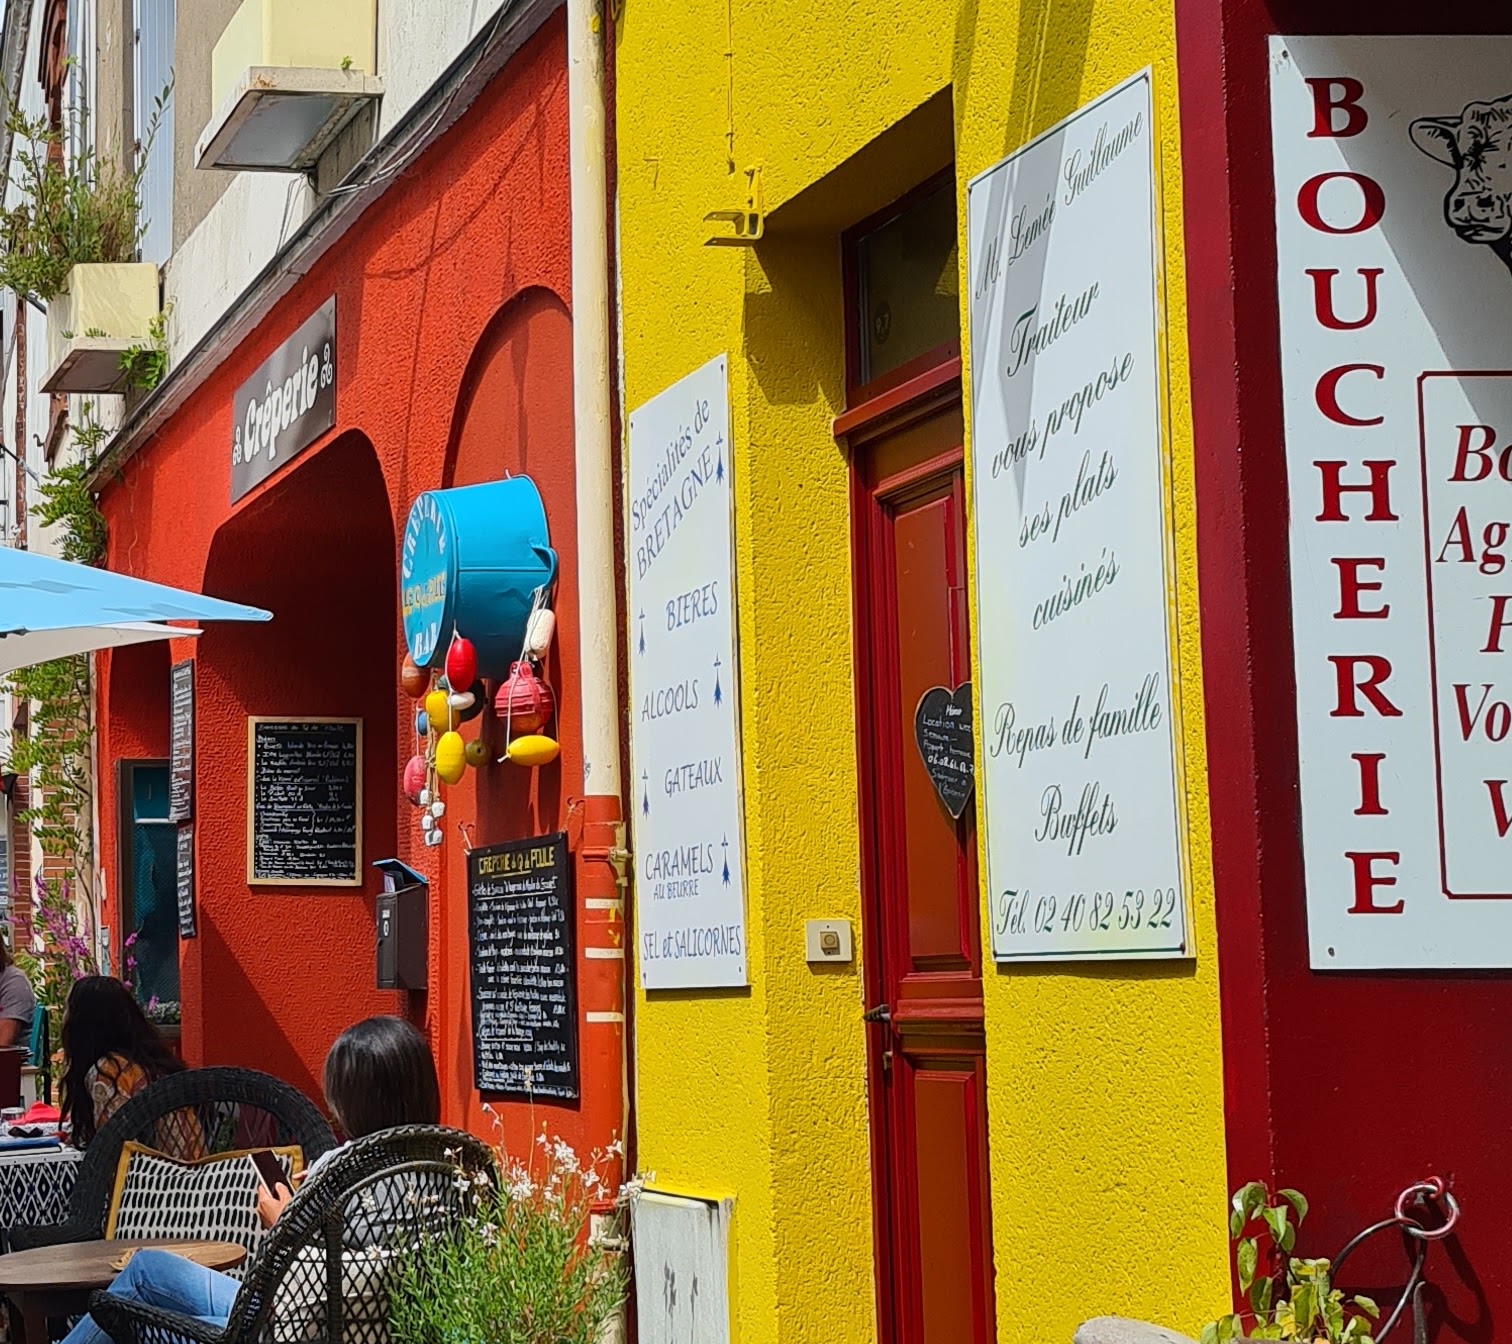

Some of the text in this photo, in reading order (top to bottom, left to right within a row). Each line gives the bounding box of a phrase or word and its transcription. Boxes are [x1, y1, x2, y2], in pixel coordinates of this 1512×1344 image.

[975, 109, 1144, 299] M. Lemée Guillaume
[1007, 279, 1100, 378] Traiteur
[244, 346, 319, 463] Crêperie
[992, 352, 1134, 480] vous propose
[632, 399, 710, 531] Spécialités de
[1020, 449, 1119, 548] ses plats
[1297, 76, 1405, 914] BOUCHERIE
[636, 445, 714, 581] BRETAGNE
[1436, 506, 1512, 575] Ag
[665, 580, 718, 632] BIERES
[1033, 547, 1121, 631] cuisinés
[642, 679, 699, 722] ALCOOLS
[990, 672, 1162, 768] Repas de famille
[664, 756, 723, 798] GATEAUX
[1034, 780, 1119, 856] Buffets
[645, 844, 713, 881] CARAMELS
[653, 879, 699, 900] AU BEURRE
[643, 925, 741, 962] SEL et SALICORNES
[996, 887, 1176, 936] Tél. 02 40 82 53 22
